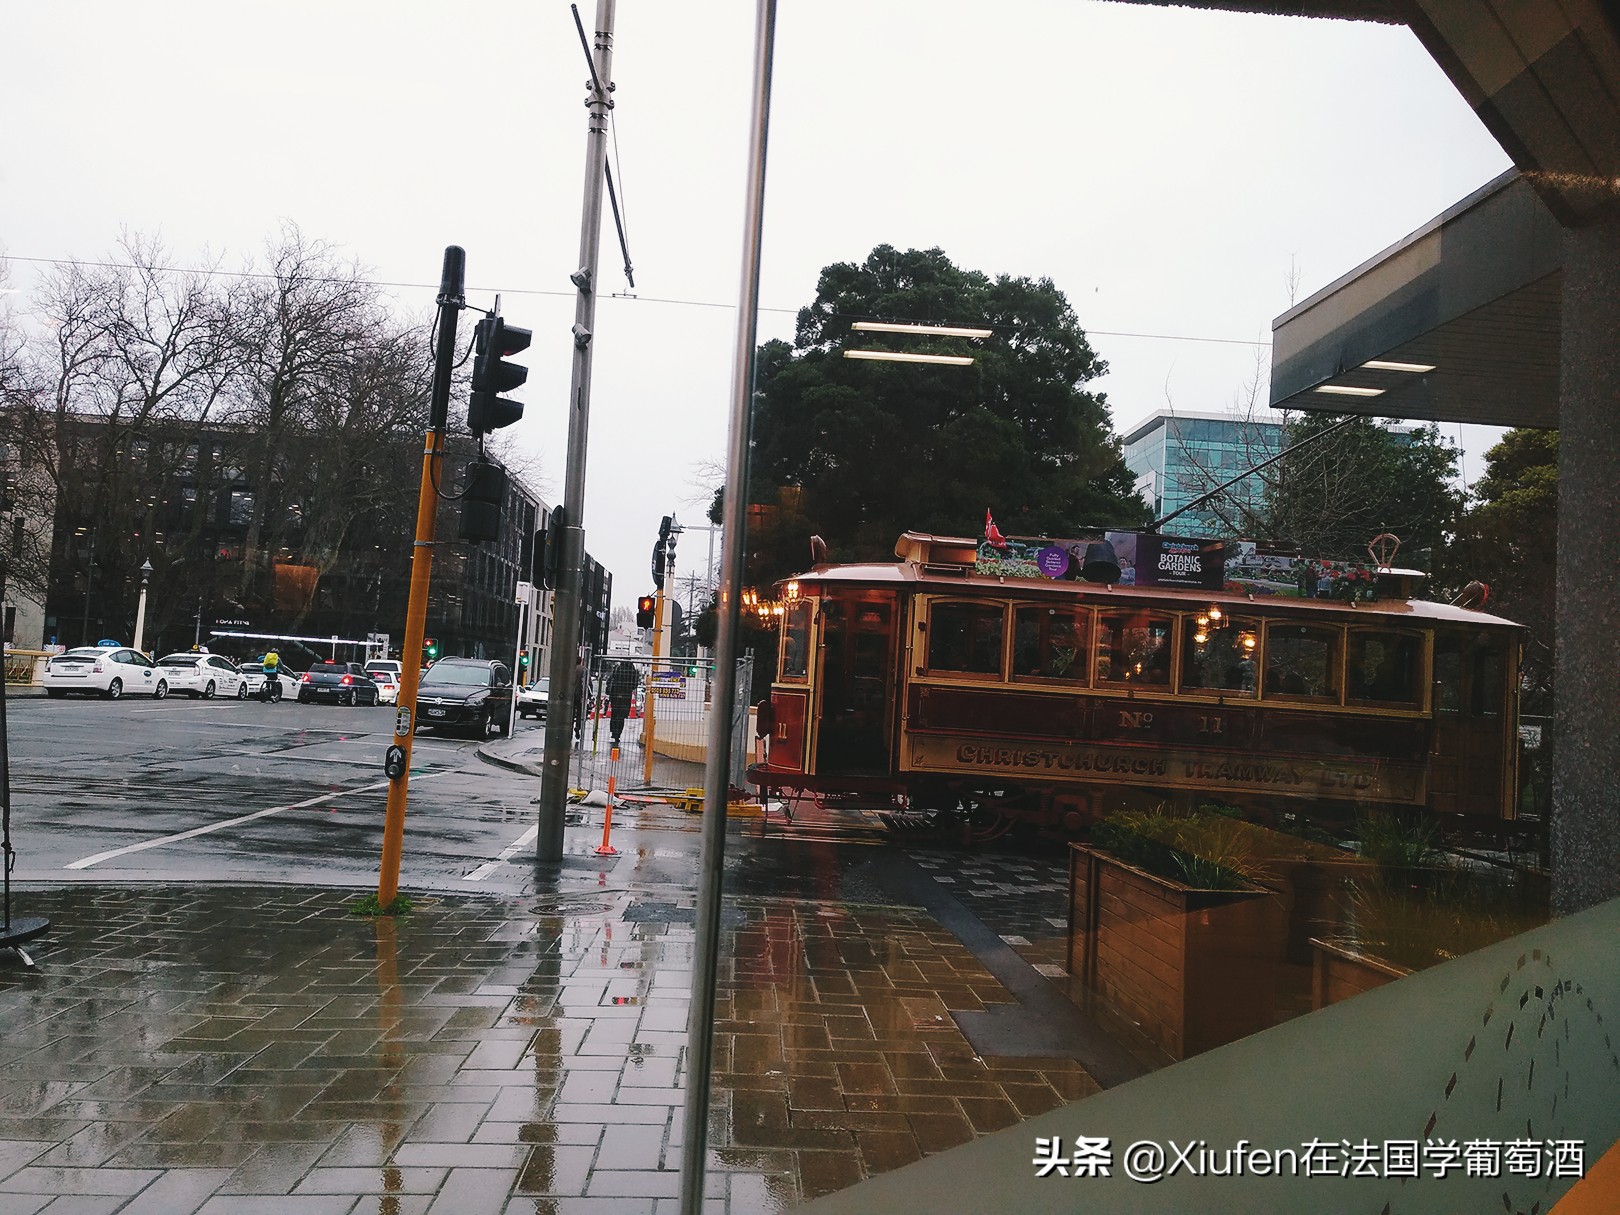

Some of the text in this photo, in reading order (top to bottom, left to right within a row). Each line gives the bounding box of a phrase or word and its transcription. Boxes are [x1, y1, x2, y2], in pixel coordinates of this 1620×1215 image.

[1158, 561, 1202, 573] GARDENS
[1160, 553, 1201, 564] BOTANIC
[777, 722, 788, 739] 11
[1200, 716, 1223, 733] 11
[956, 743, 1373, 790] CHRISTCHURCH TRAMWAY LTD
